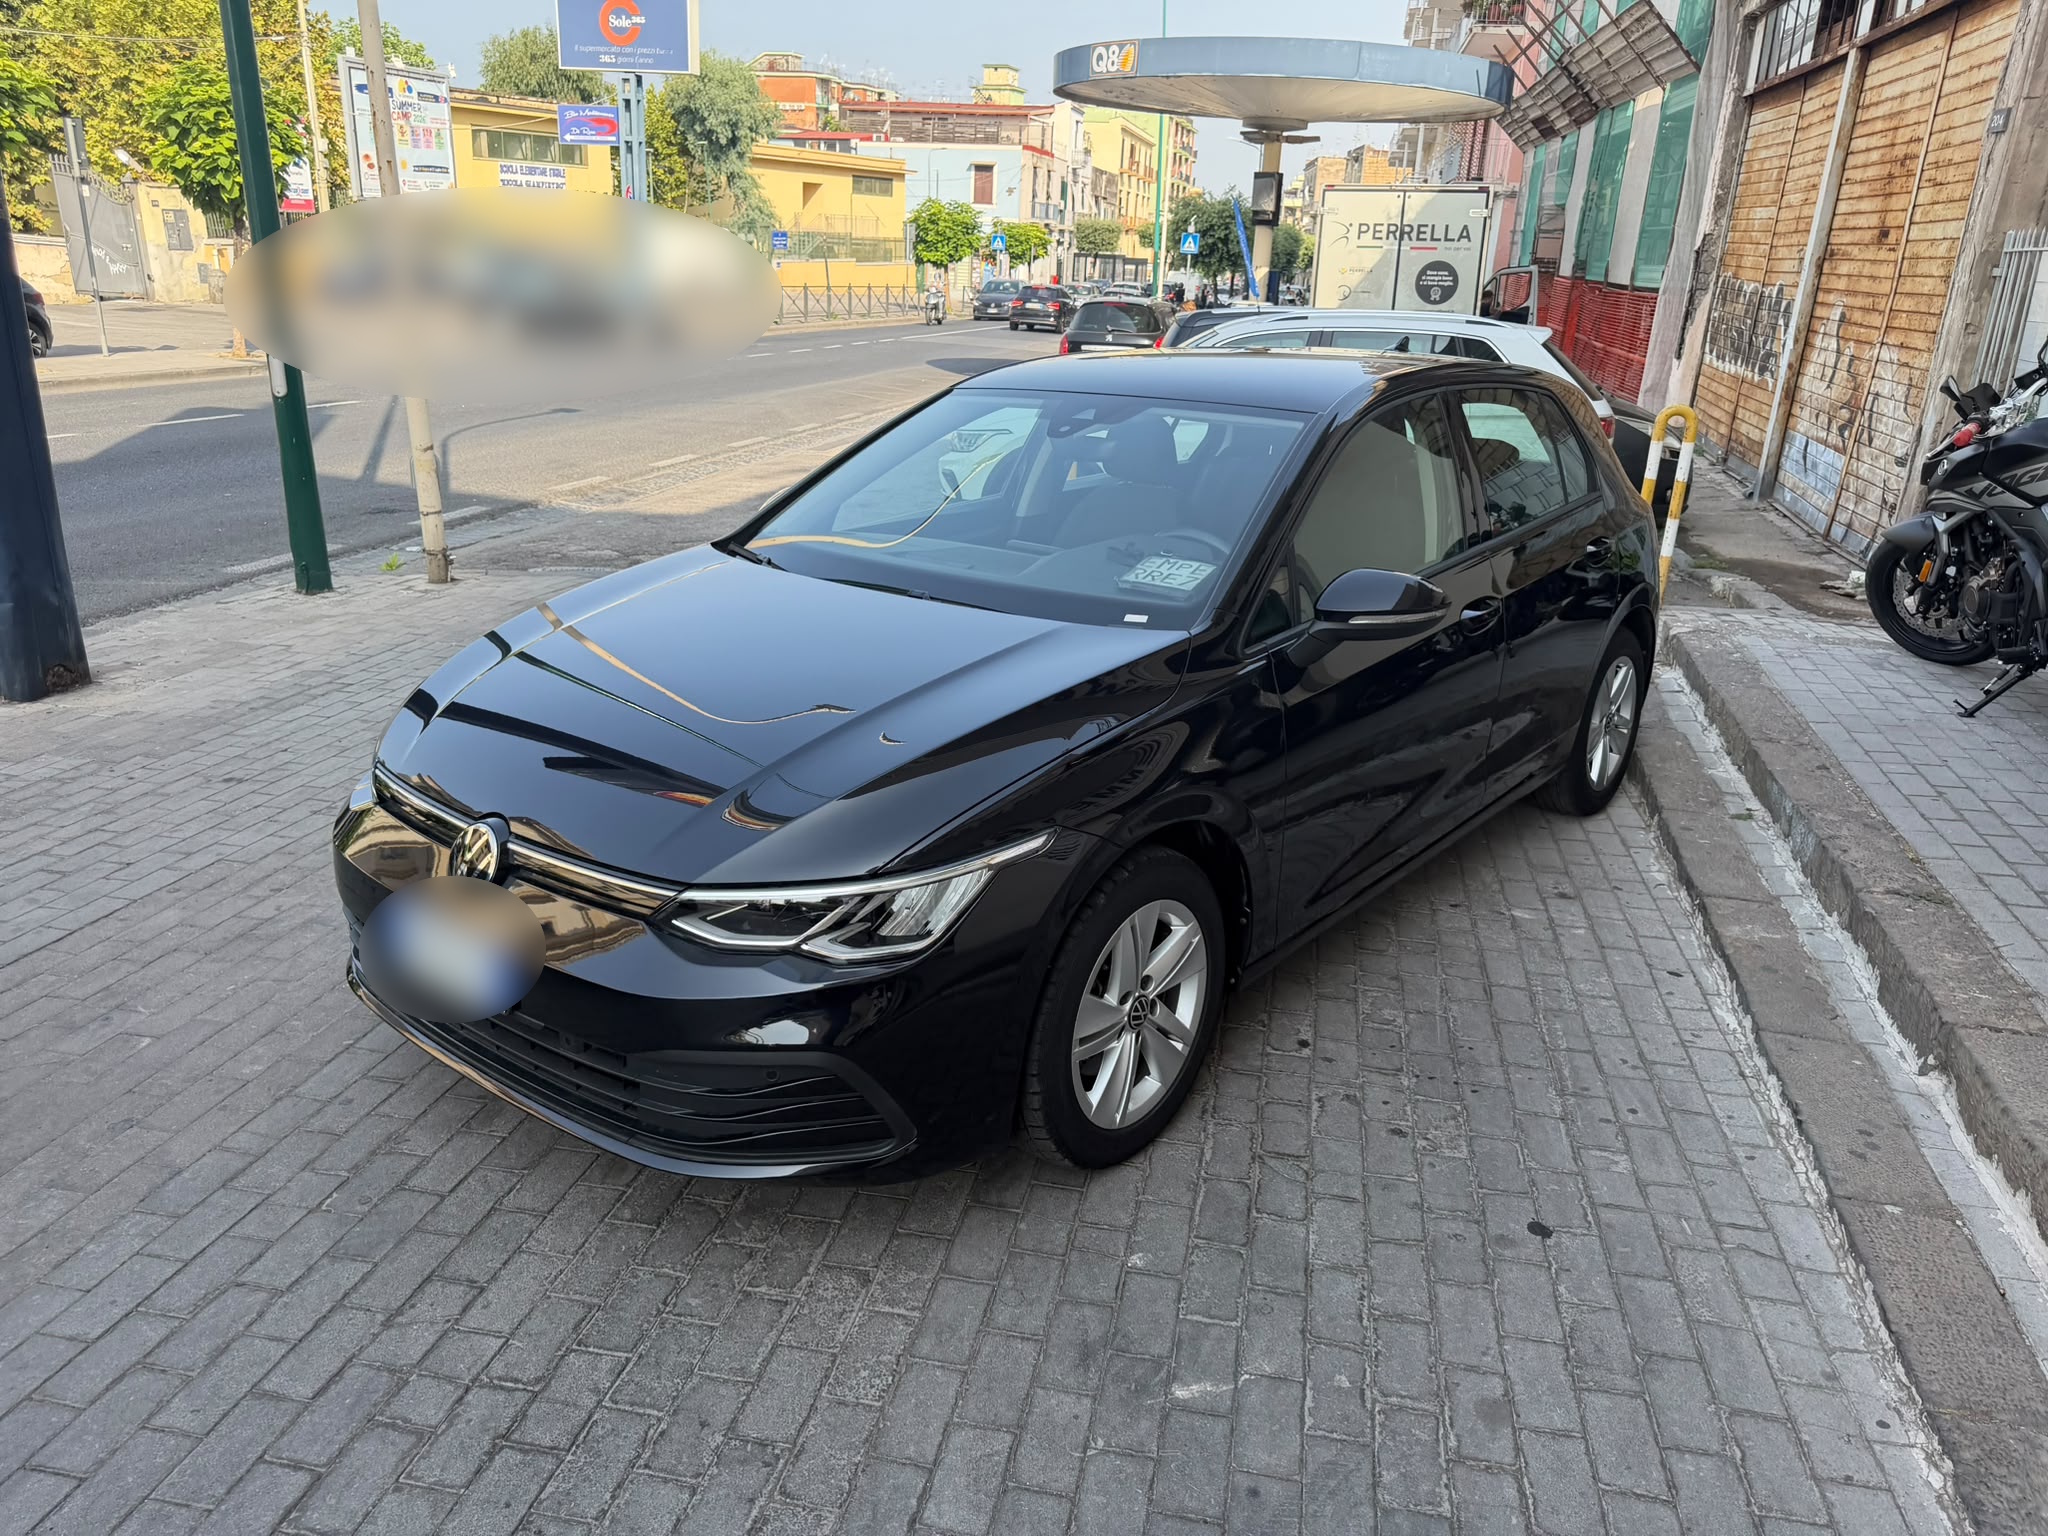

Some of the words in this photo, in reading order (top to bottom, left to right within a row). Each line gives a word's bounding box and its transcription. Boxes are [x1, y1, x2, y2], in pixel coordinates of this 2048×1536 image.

[579, 45, 621, 53] supermercato
[637, 47, 655, 55] prezzi
[599, 54, 616, 63] 365
[1092, 44, 1120, 73] Q8
[391, 99, 423, 113] SUMMER
[391, 111, 412, 121] CAMP
[1356, 222, 1472, 243] PERRELLA
